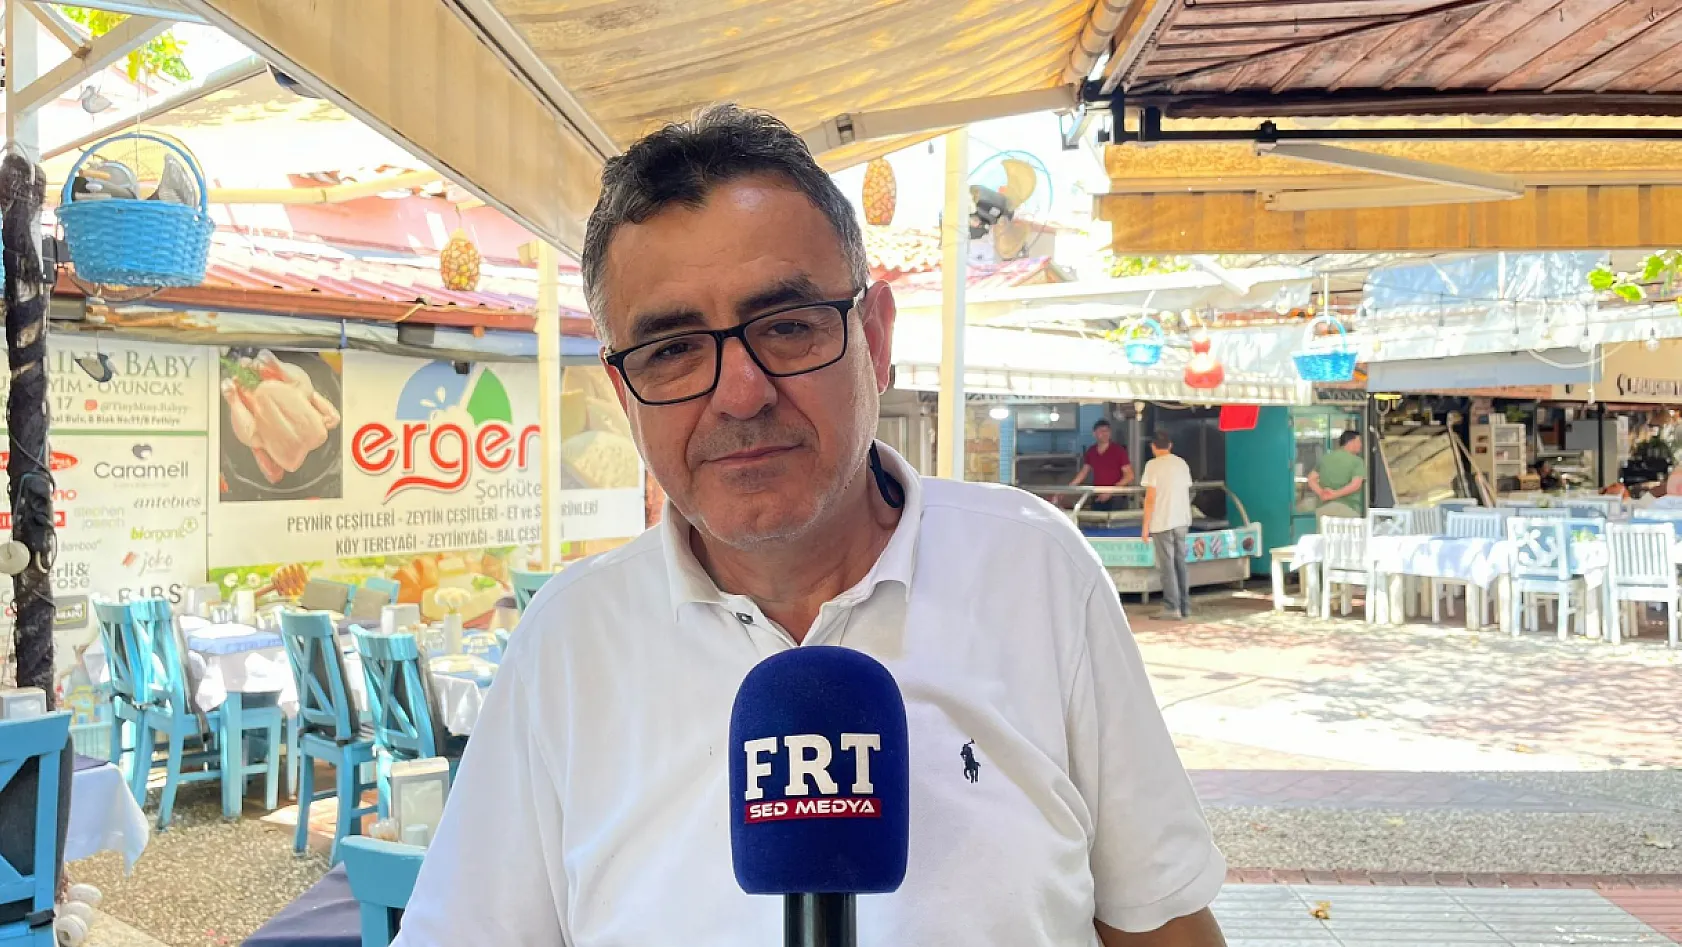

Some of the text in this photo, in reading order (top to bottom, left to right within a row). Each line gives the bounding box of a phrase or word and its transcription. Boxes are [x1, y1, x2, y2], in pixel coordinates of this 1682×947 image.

[125, 350, 198, 379] BABY
[97, 380, 185, 396] OYUNCAK
[57, 396, 73, 411] 17
[94, 461, 189, 479] Caramell
[53, 488, 77, 501] no
[476, 478, 541, 505] Şarküte
[287, 513, 332, 532] PEYNİR
[336, 508, 395, 534] ÇEŞİTLERİ
[406, 507, 443, 526] ZEYTİN
[447, 503, 498, 528] ÇEŞİTLERİ
[507, 504, 518, 520] ET
[336, 536, 359, 555] KÖY
[363, 534, 417, 554] TEREYAĞI
[427, 528, 487, 549] ZEYTİNYAĞI
[497, 527, 516, 544] BAL
[744, 732, 881, 801] FRT
[750, 799, 876, 819] SED MEDYA
